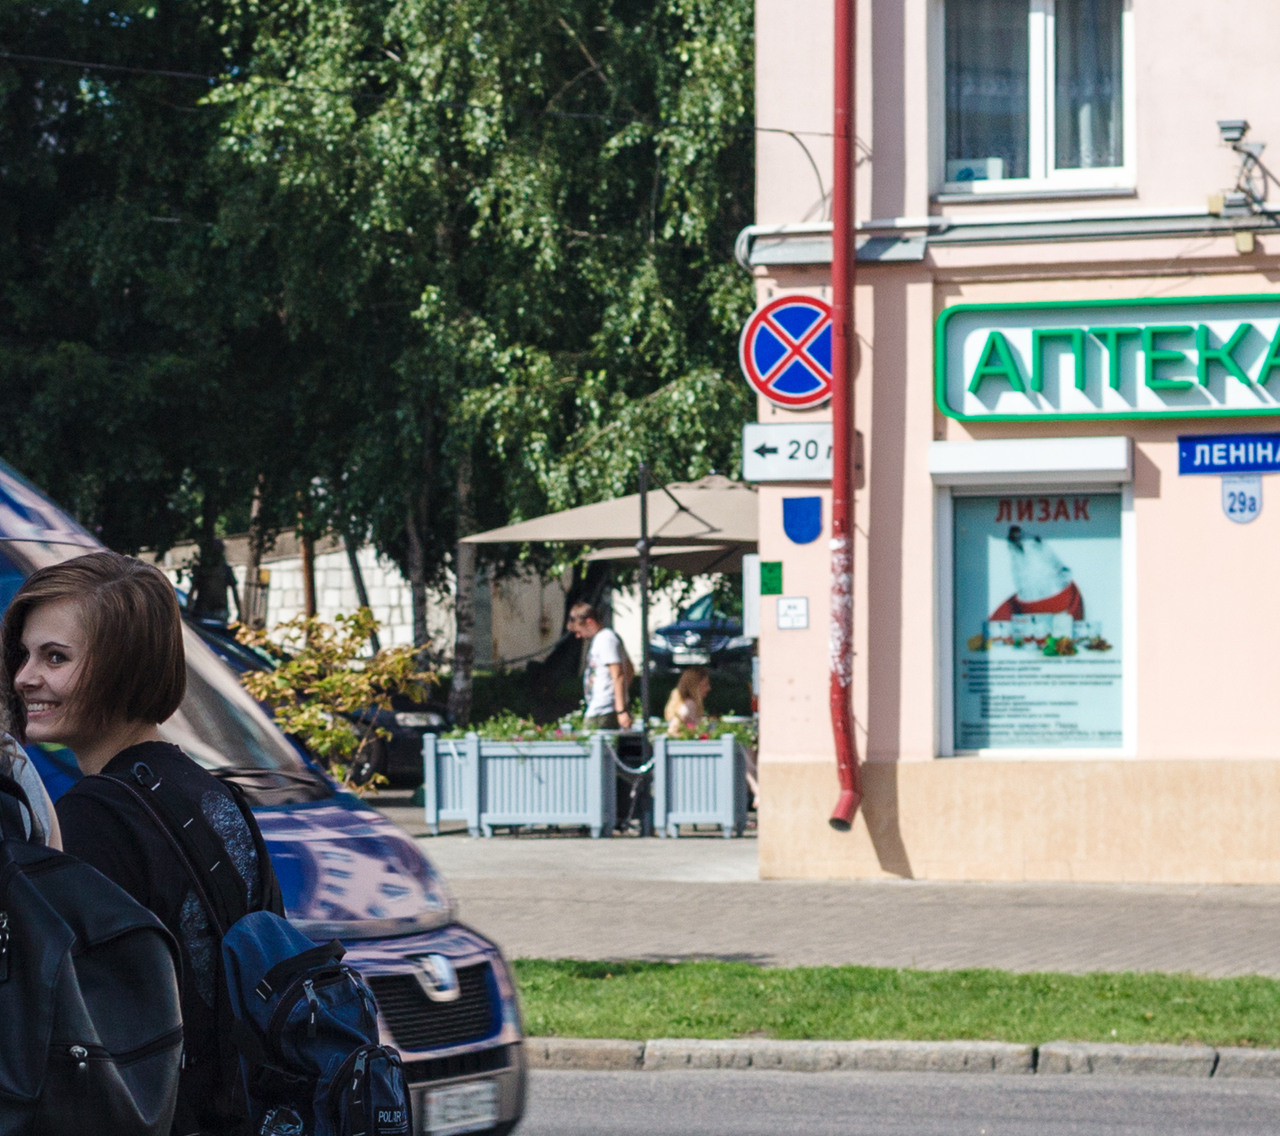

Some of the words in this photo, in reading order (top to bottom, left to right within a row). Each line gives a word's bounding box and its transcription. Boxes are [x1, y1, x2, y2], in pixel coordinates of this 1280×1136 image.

[788, 440, 819, 460] 20
[1193, 440, 1280, 467] ЛЕНІН
[995, 497, 1090, 522] ЛИЗАК
